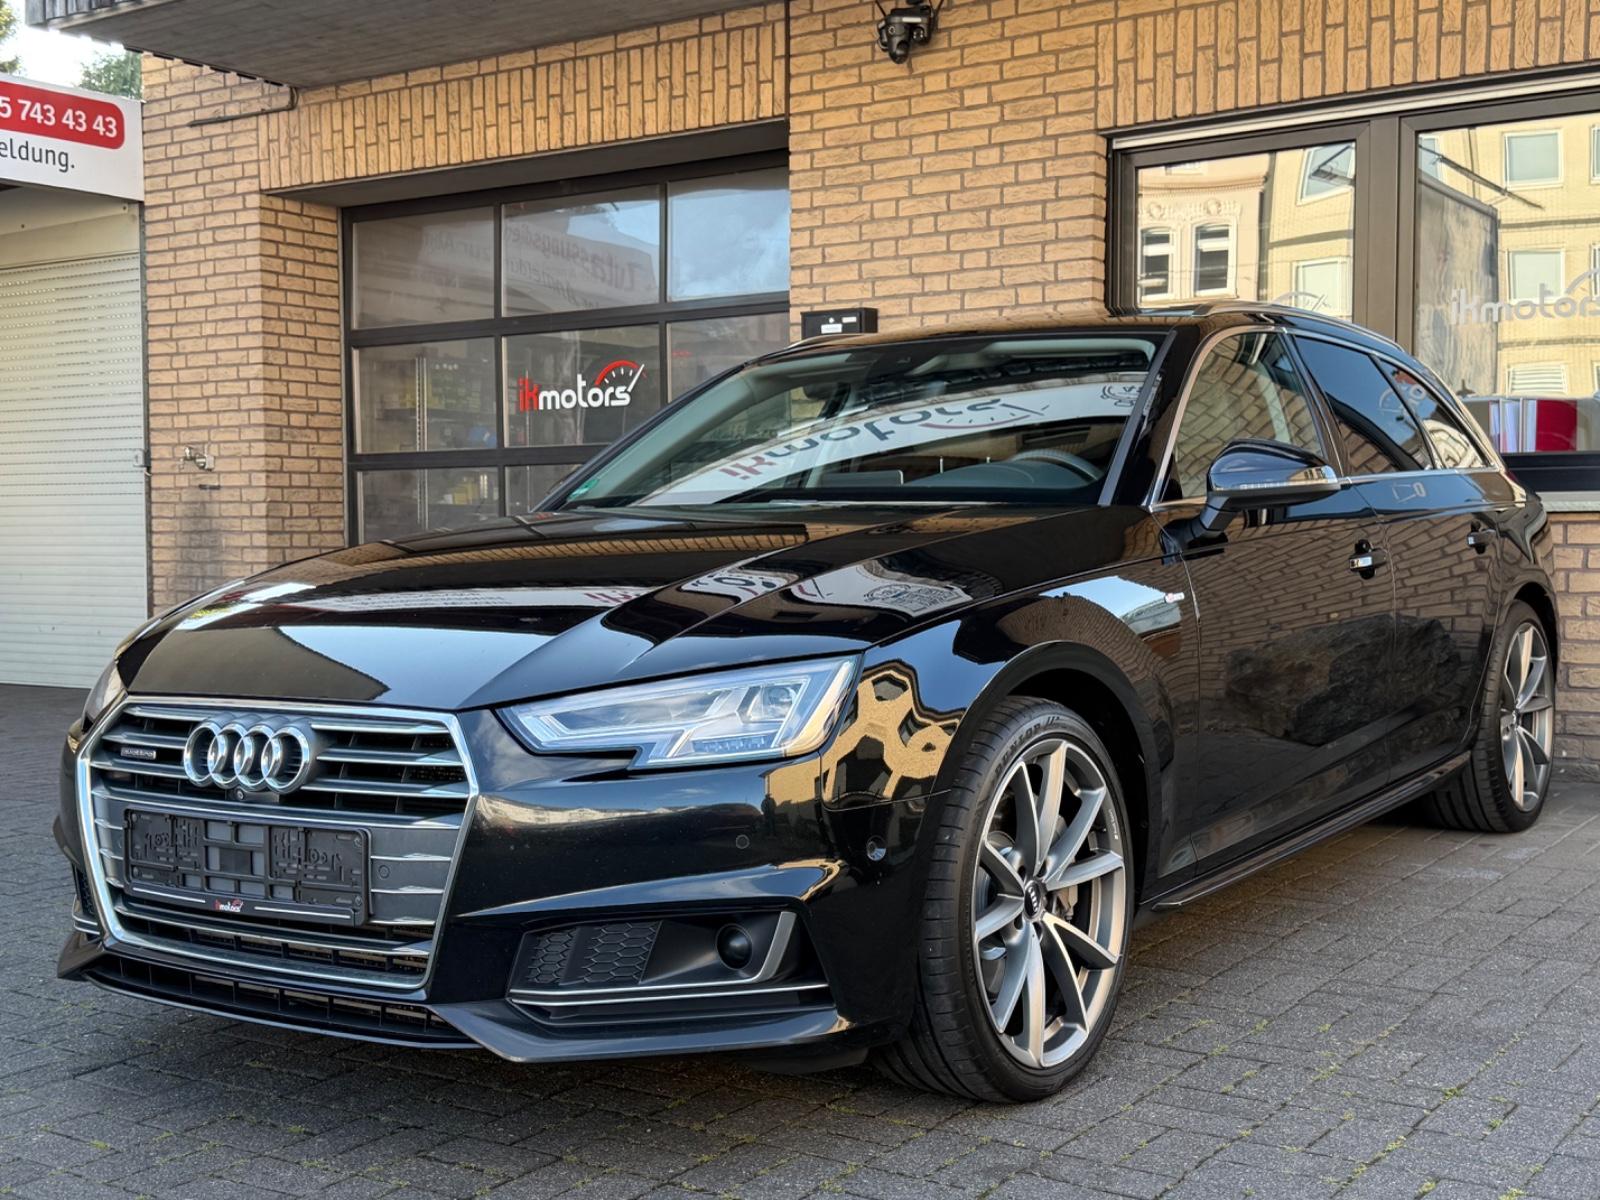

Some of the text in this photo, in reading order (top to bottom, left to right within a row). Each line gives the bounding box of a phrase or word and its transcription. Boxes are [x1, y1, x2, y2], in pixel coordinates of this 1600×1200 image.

[17, 100, 56, 126] 743
[62, 109, 87, 132] 43
[92, 115, 117, 138] 43
[0, 138, 75, 173] eldung.
[518, 374, 631, 412] ikmotors
